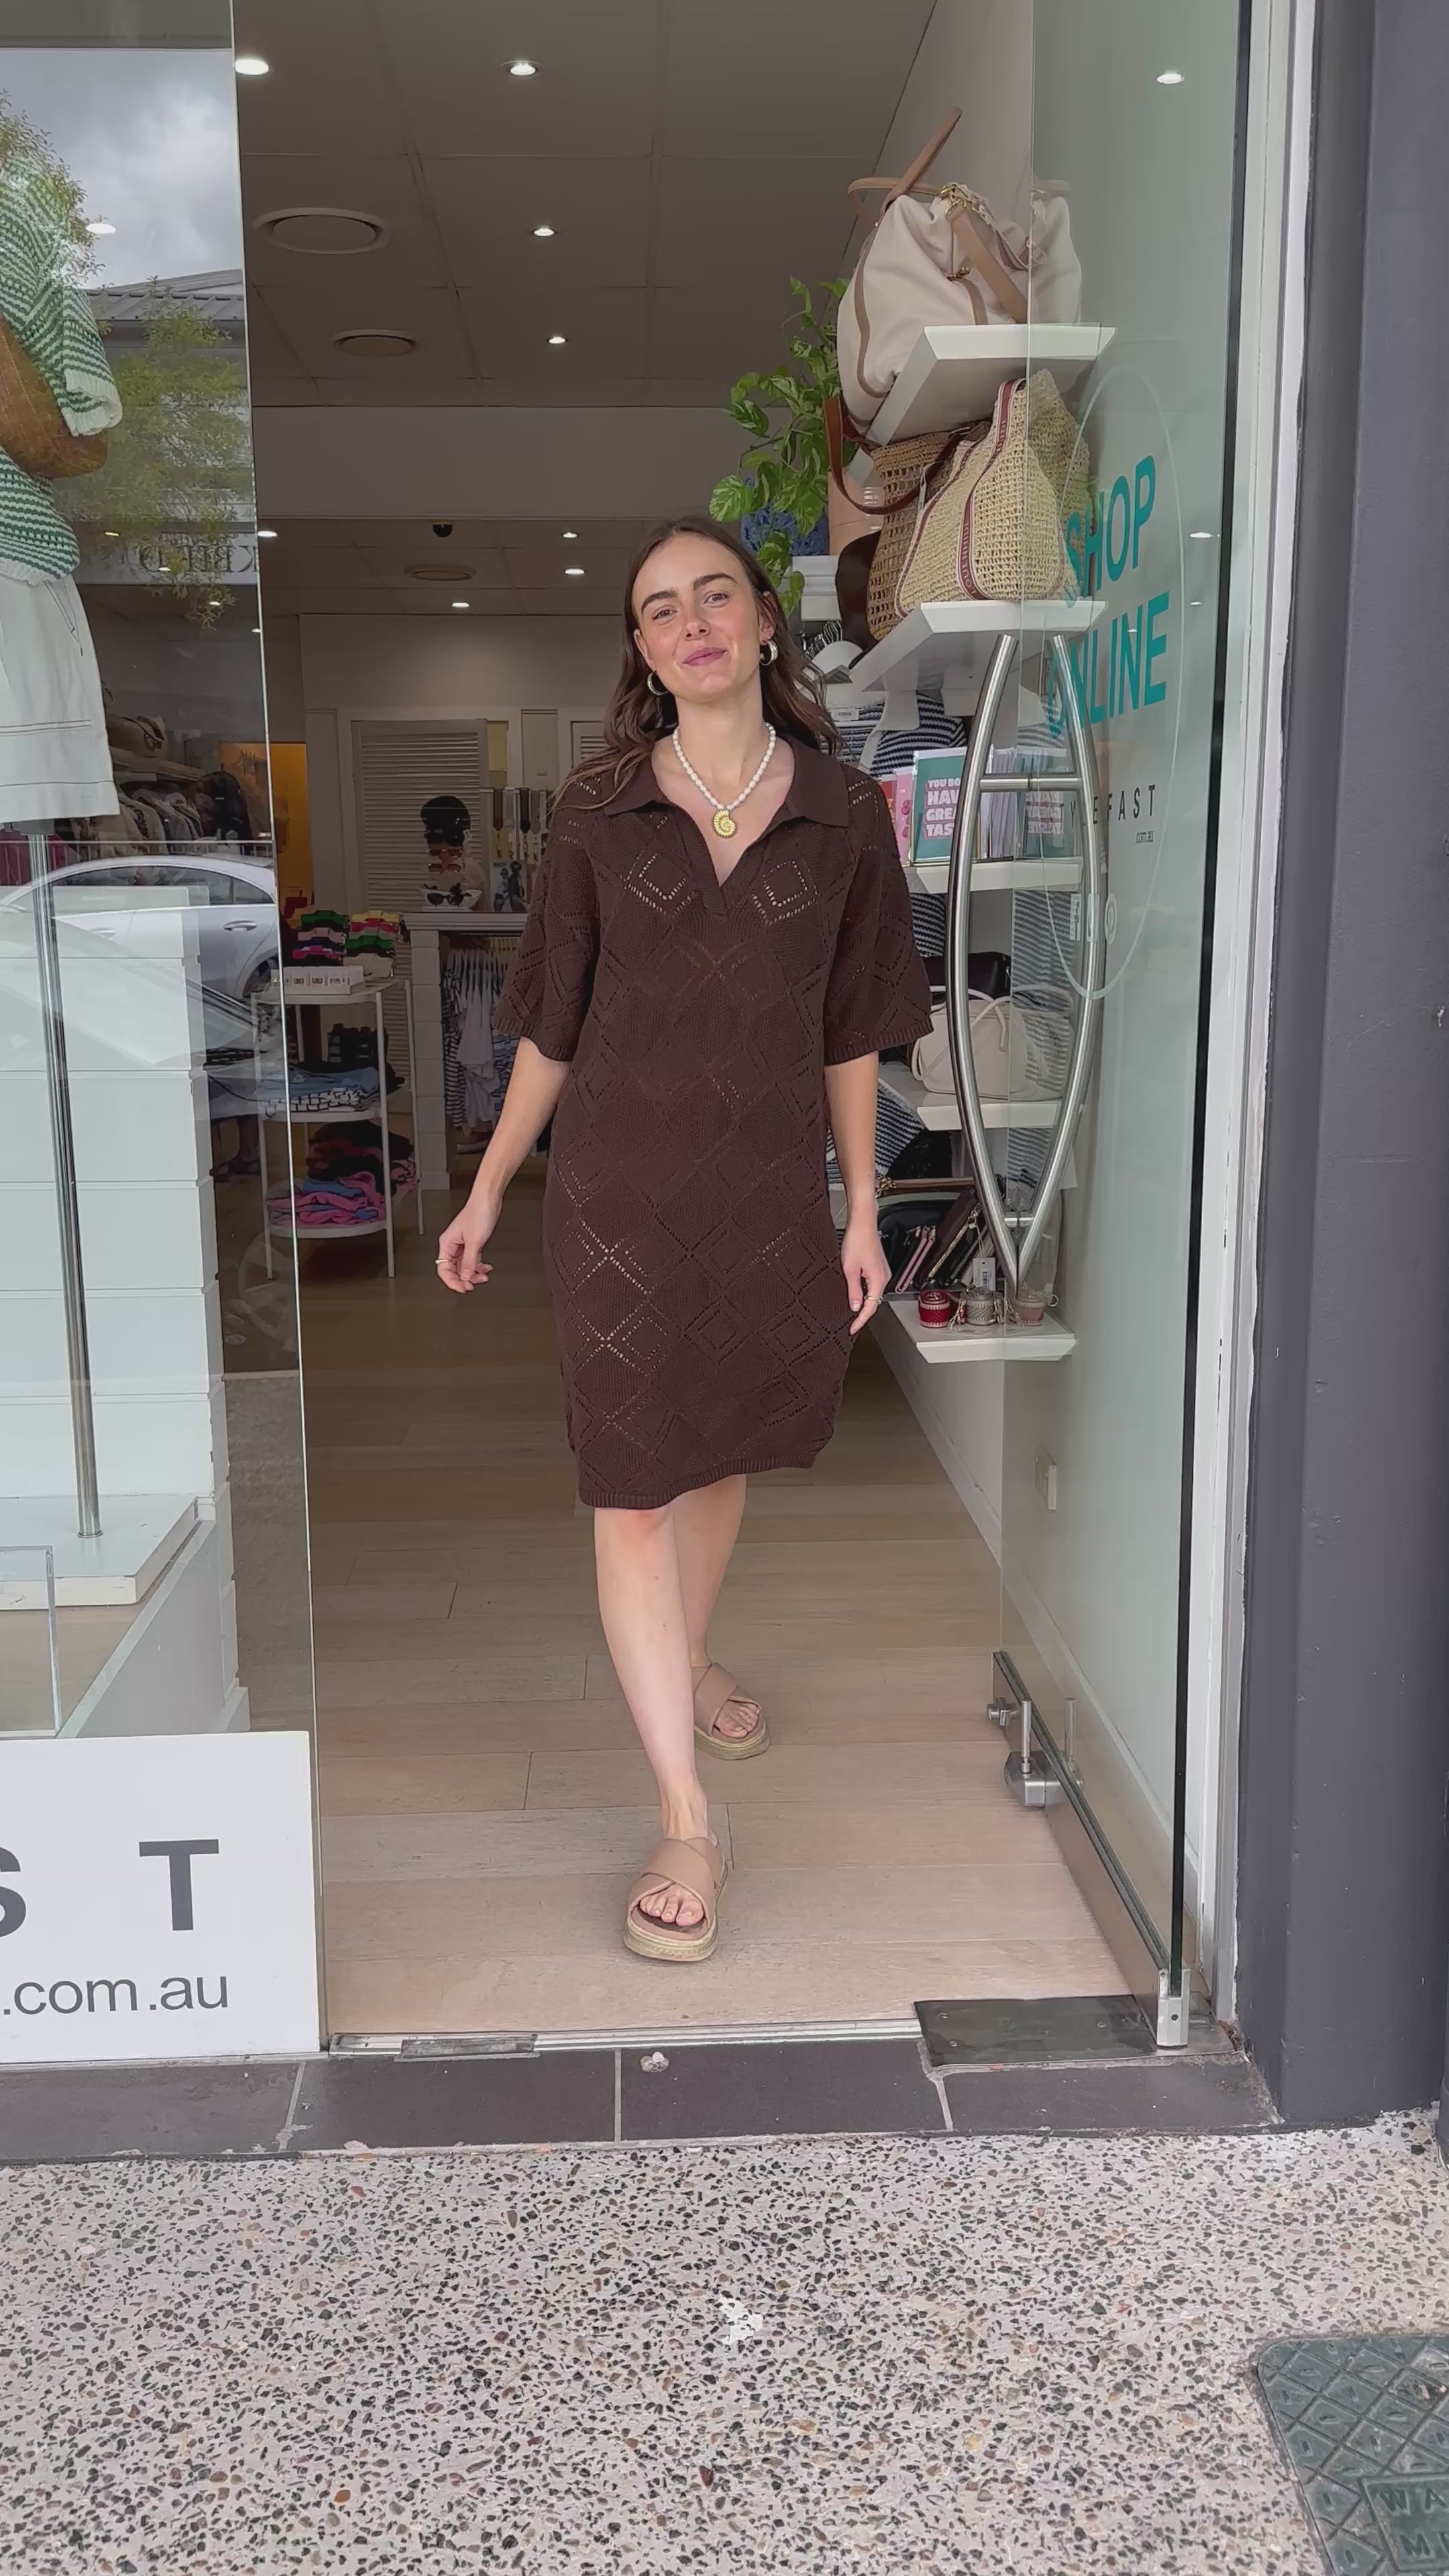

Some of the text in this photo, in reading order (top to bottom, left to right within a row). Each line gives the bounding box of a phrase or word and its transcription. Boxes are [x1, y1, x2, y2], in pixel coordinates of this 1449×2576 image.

[1063, 455, 1156, 608] SHOP
[1049, 590, 1170, 739] ONLINE
[928, 778, 947, 788] YOU
[3, 1976, 228, 2015] .com.au
